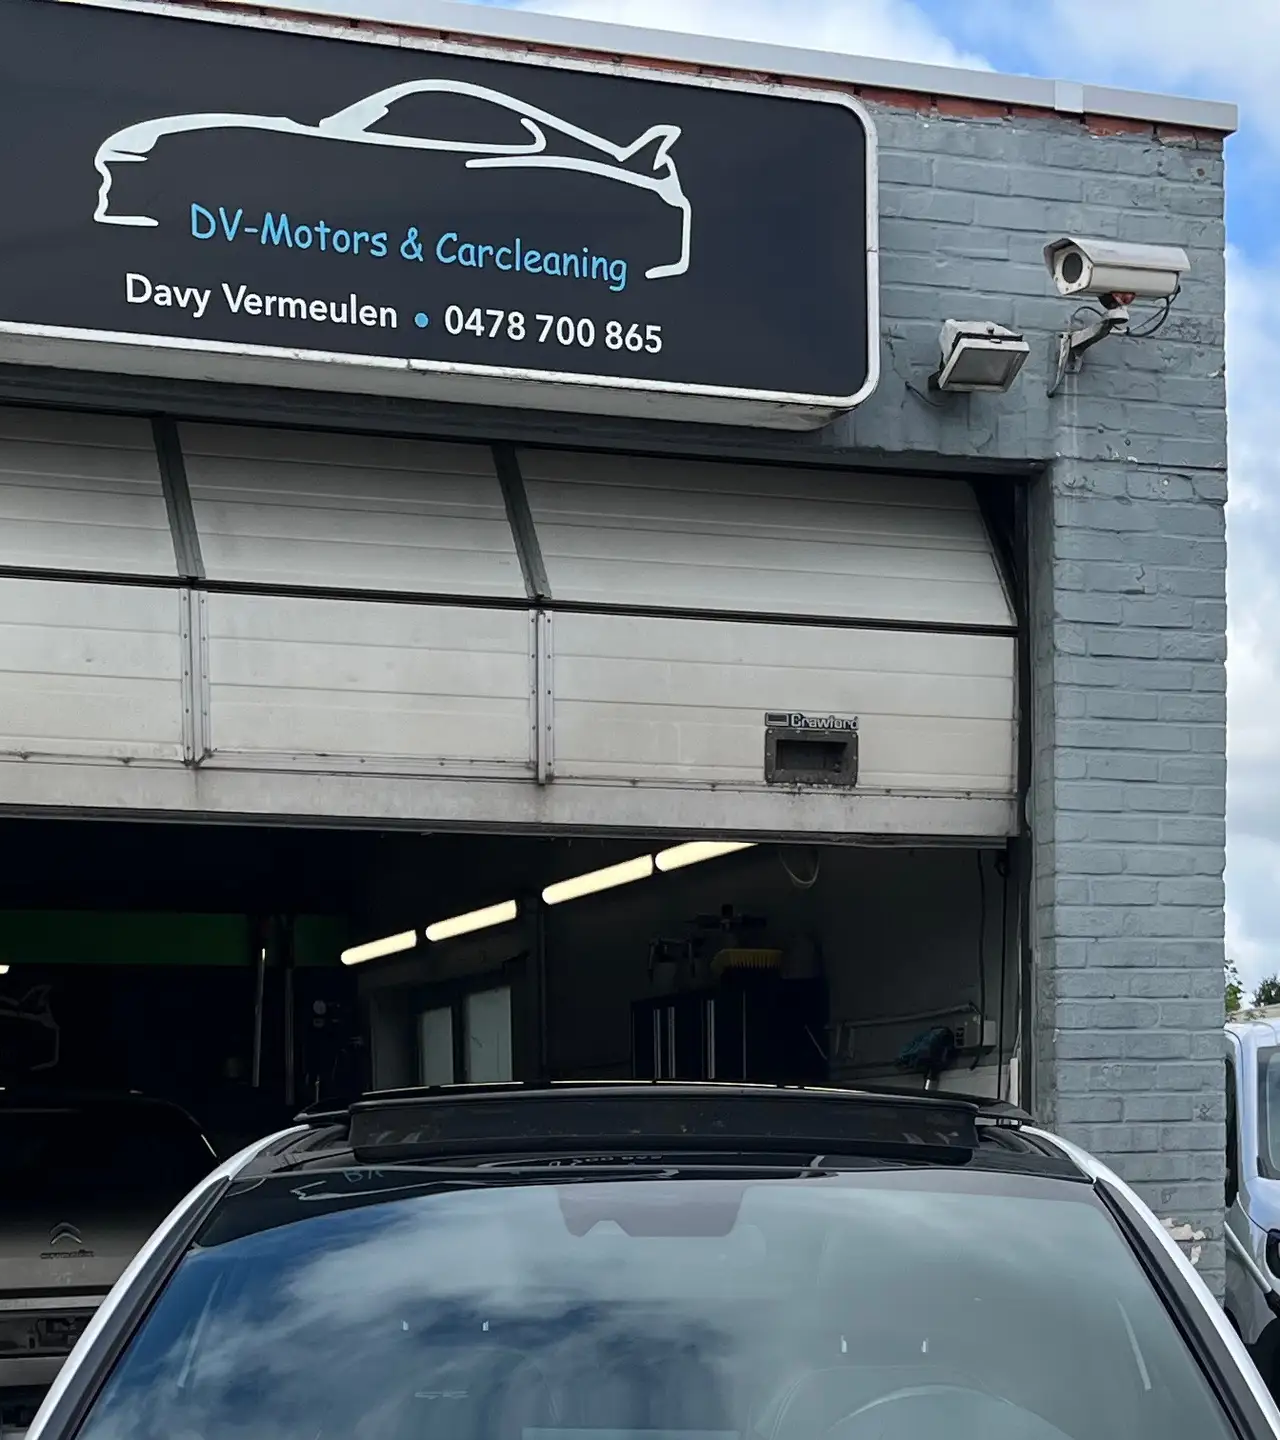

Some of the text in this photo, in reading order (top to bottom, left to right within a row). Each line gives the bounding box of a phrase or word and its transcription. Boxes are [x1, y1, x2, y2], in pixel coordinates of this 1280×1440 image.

[190, 203, 628, 291] DV-Motors & Carcleaning
[125, 273, 663, 354] Davy Vermeulen 0478 700 865
[791, 713, 859, 730] Crawford
